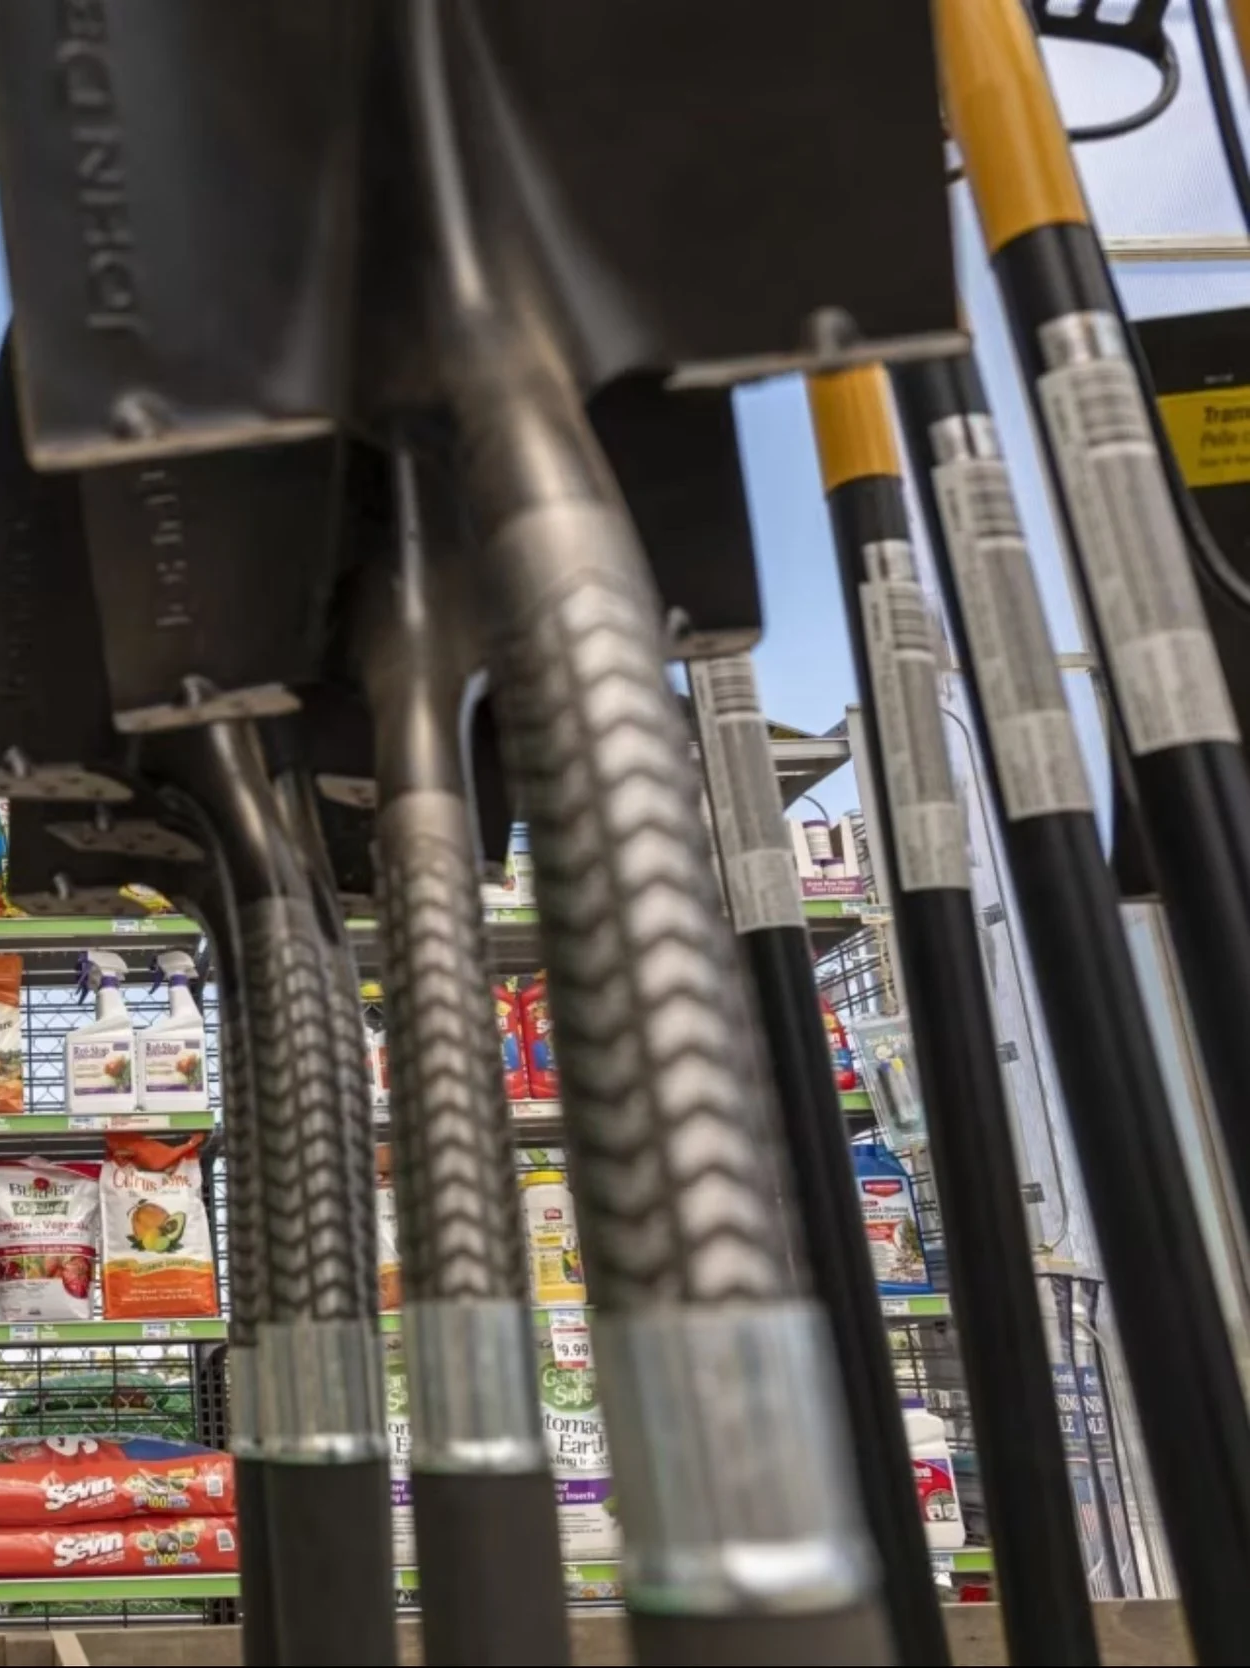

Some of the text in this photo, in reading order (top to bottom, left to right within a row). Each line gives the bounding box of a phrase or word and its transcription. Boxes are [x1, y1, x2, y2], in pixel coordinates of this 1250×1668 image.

[554, 1384, 595, 1406] Safe
[44, 1475, 116, 1511] Sevin
[53, 1531, 126, 1567] Sevin
